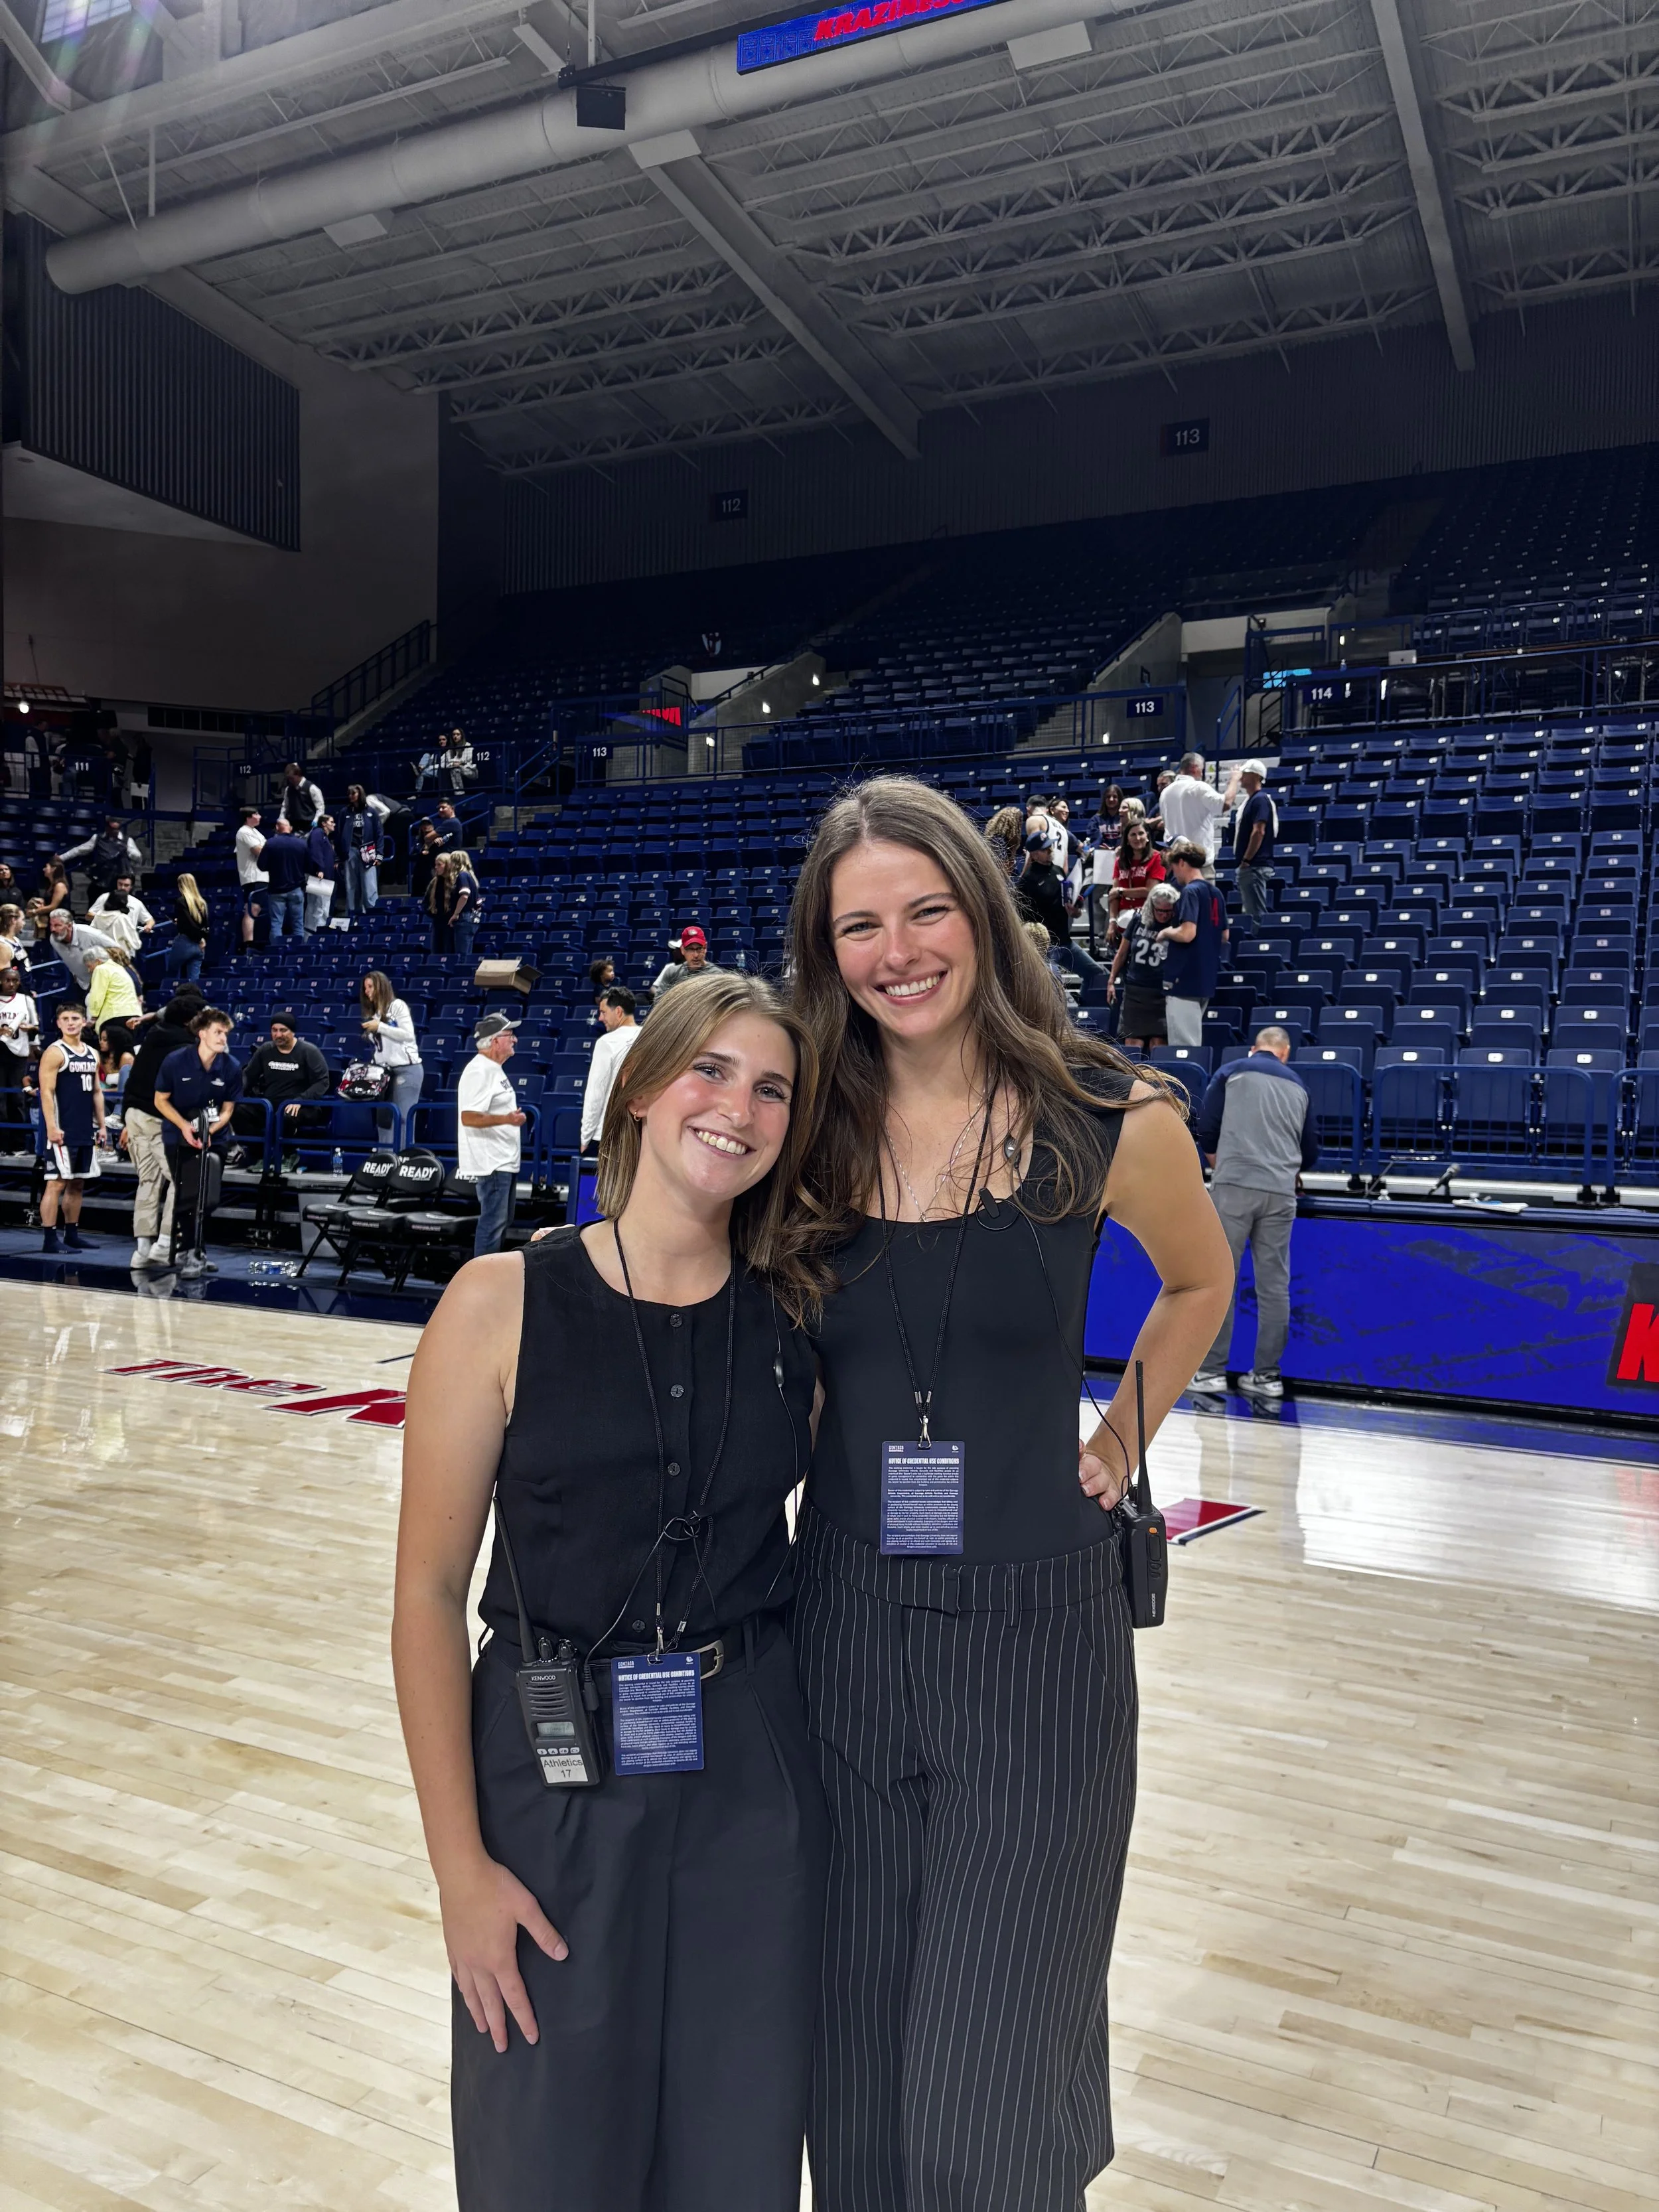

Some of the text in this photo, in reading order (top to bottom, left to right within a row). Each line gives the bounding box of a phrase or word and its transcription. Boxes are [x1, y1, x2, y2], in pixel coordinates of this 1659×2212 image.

[814, 0, 963, 40] KRAZINE
[1175, 429, 1200, 446] 113
[722, 498, 741, 513] 112
[1311, 687, 1333, 700] 114
[1135, 701, 1155, 714] 113
[476, 751, 490, 761] 112
[593, 747, 607, 757] 113
[74, 762, 89, 771] 111
[240, 765, 252, 774] 112
[1135, 939, 1164, 967] 23
[69, 1061, 96, 1072] GONZAG
[80, 1074, 92, 1092] 10
[362, 1161, 392, 1174] READY
[399, 1165, 436, 1179] READY
[100, 1358, 327, 1396] The
[543, 1759, 583, 1768] Athletics
[561, 1769, 571, 1779] 17
